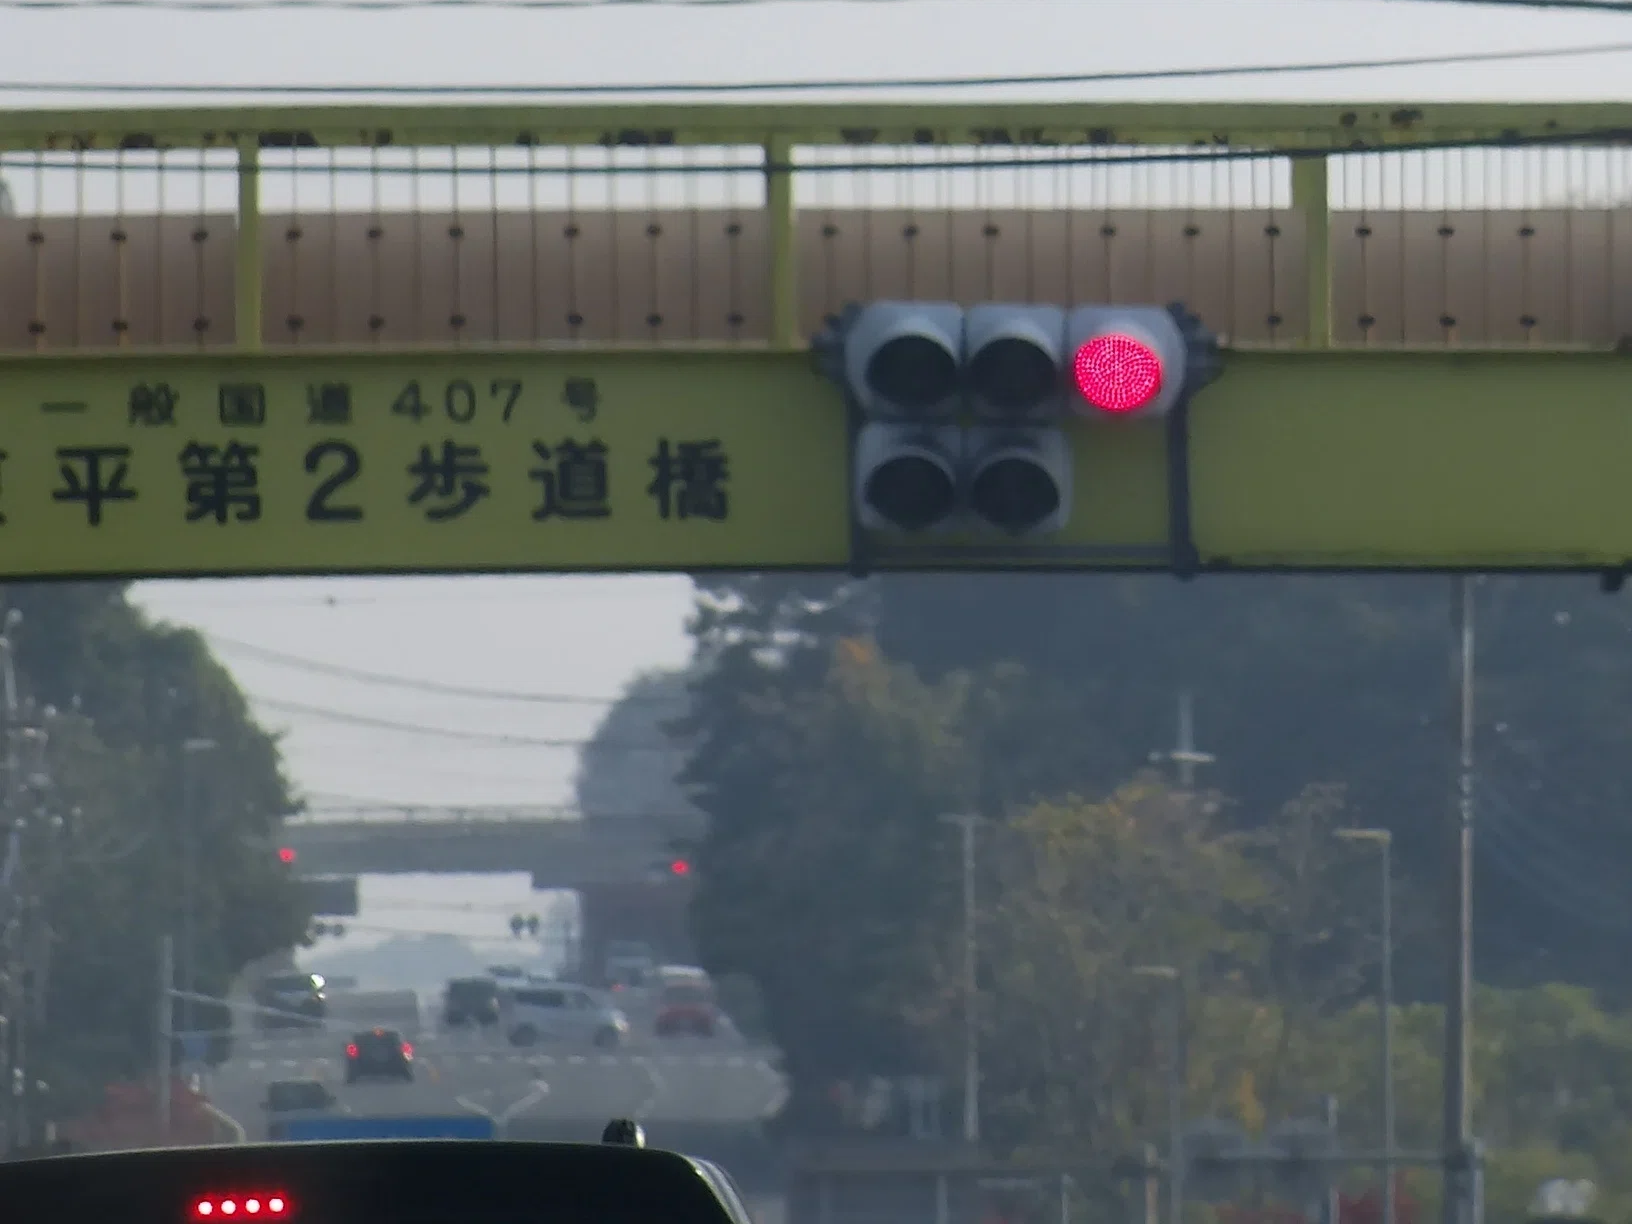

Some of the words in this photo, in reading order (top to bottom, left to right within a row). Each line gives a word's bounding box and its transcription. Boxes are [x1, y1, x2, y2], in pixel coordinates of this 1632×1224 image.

[0, 438, 731, 526] 平第2歩道橋
